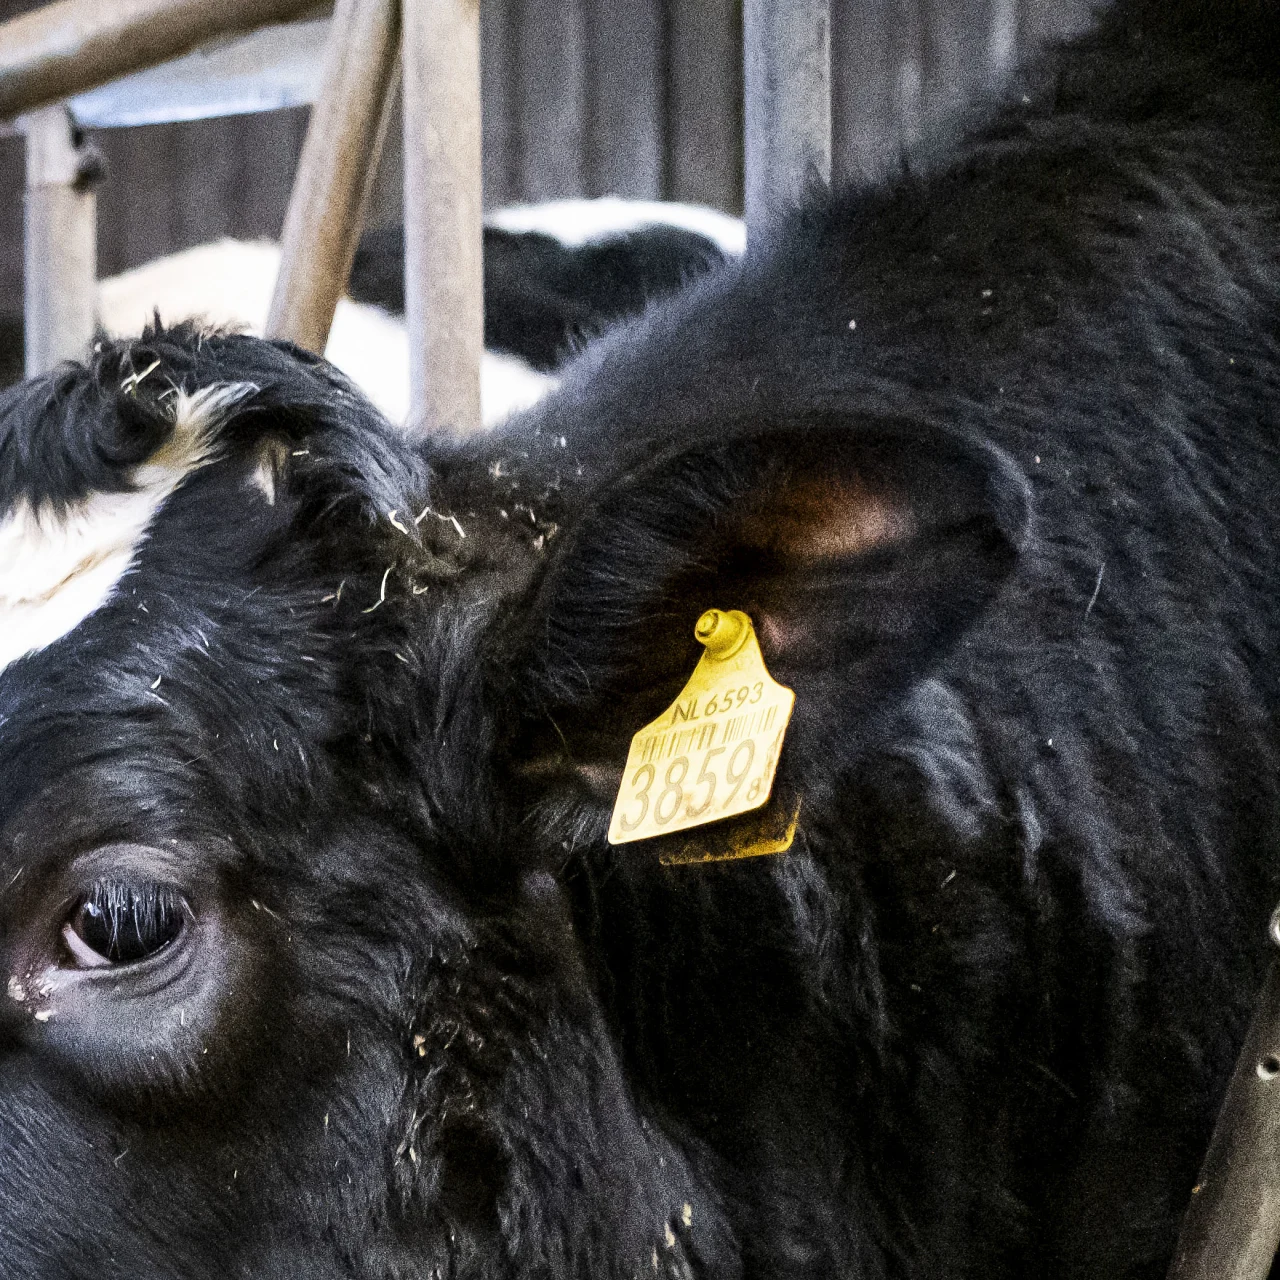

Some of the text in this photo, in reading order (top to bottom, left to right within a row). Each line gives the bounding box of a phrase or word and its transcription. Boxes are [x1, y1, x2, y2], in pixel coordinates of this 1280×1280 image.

[671, 681, 764, 725] NL 6593
[620, 738, 756, 832] 3859
